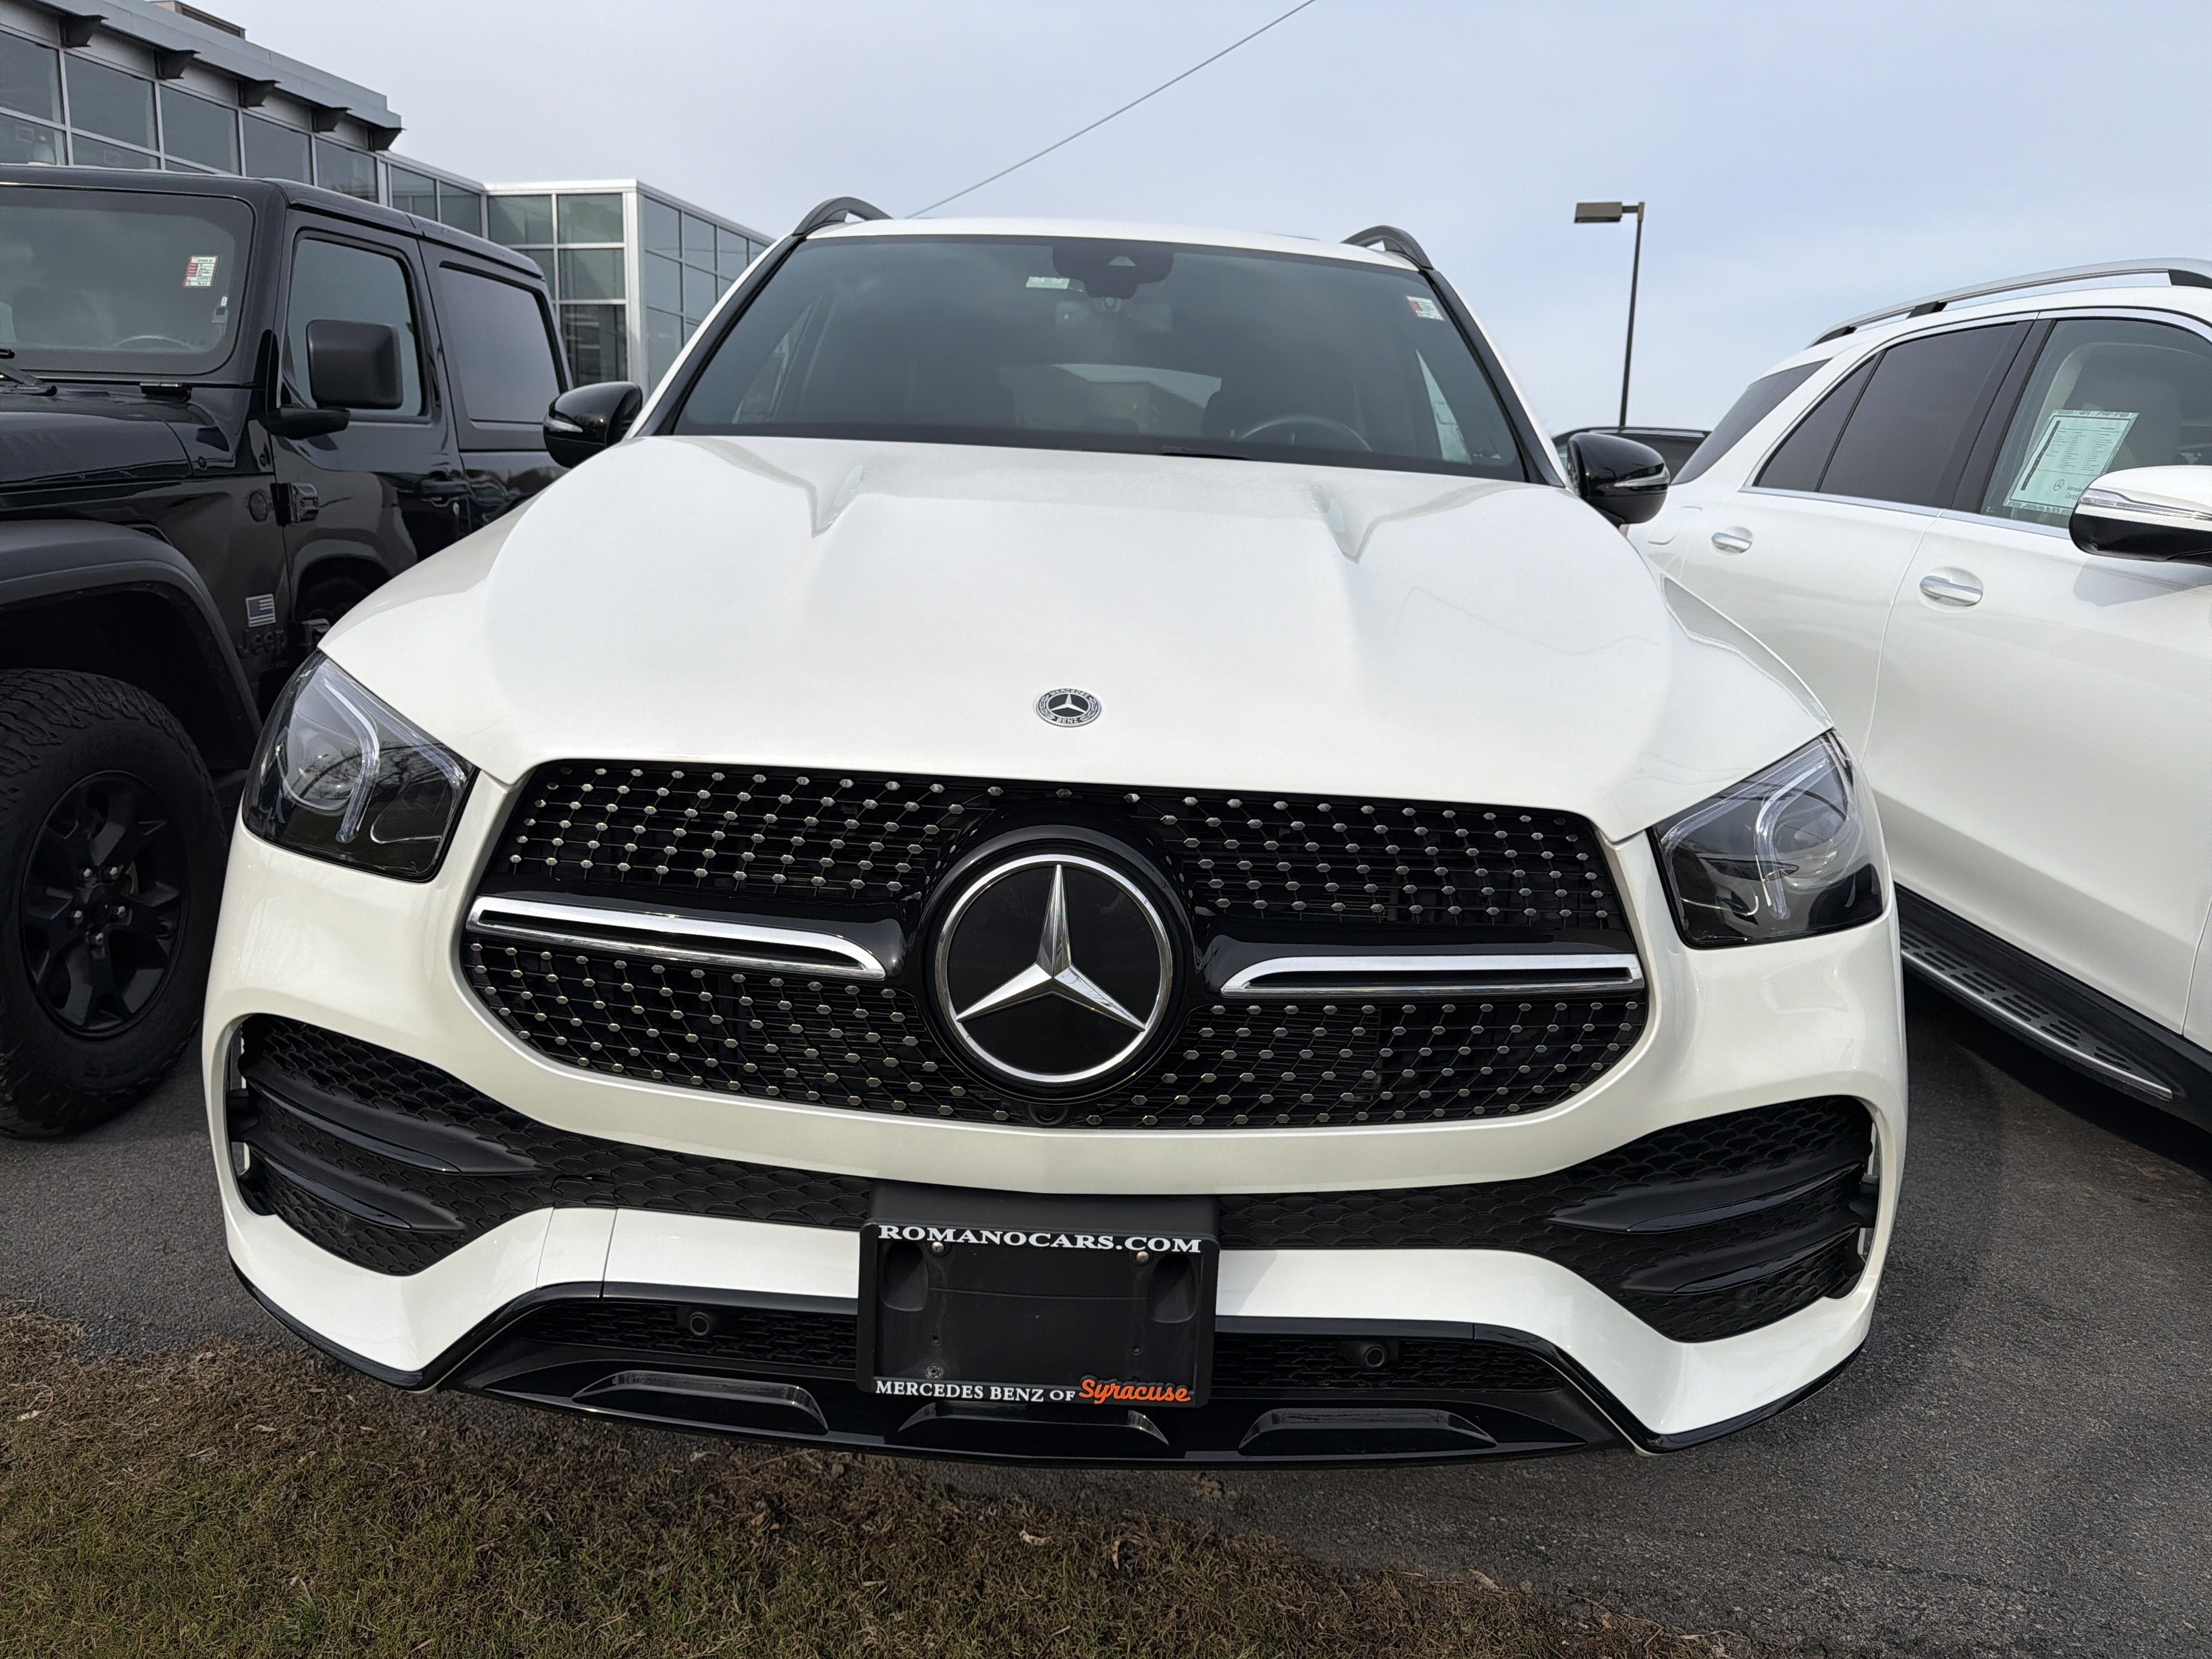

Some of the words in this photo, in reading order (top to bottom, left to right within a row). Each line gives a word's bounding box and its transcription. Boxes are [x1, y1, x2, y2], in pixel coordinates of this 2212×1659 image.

[1050, 689, 1089, 697] MERCEDES
[878, 1224, 1202, 1253] ROMANOCARS.COM
[875, 1380, 984, 1398] MERCEDES
[990, 1386, 1044, 1402] BENZ
[1049, 1390, 1076, 1401] OF
[1079, 1379, 1192, 1404] Syracuse
